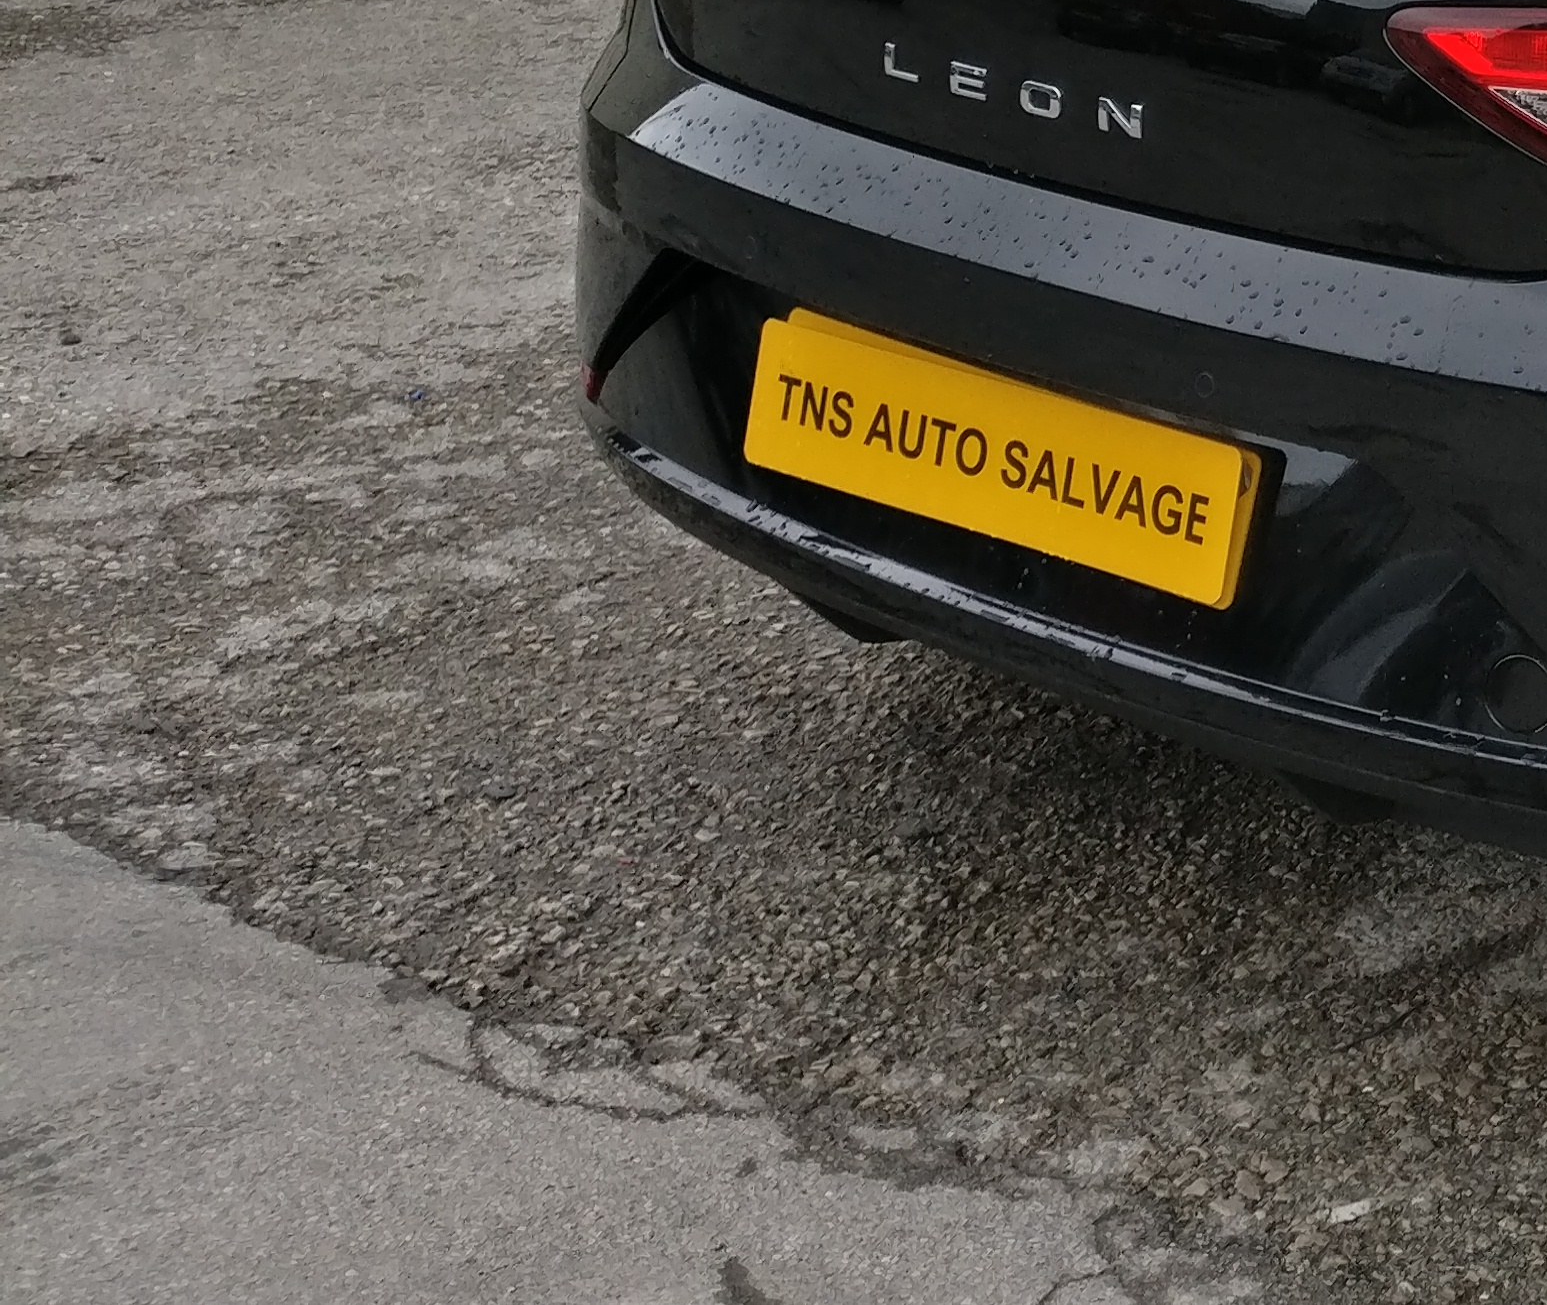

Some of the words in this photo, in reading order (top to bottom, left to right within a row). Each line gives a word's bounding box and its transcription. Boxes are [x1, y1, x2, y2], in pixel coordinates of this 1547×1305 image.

[884, 41, 1144, 139] LEON
[778, 373, 855, 439] TNS
[863, 402, 988, 477] AUTO
[1000, 438, 1210, 546] SALVAGE
